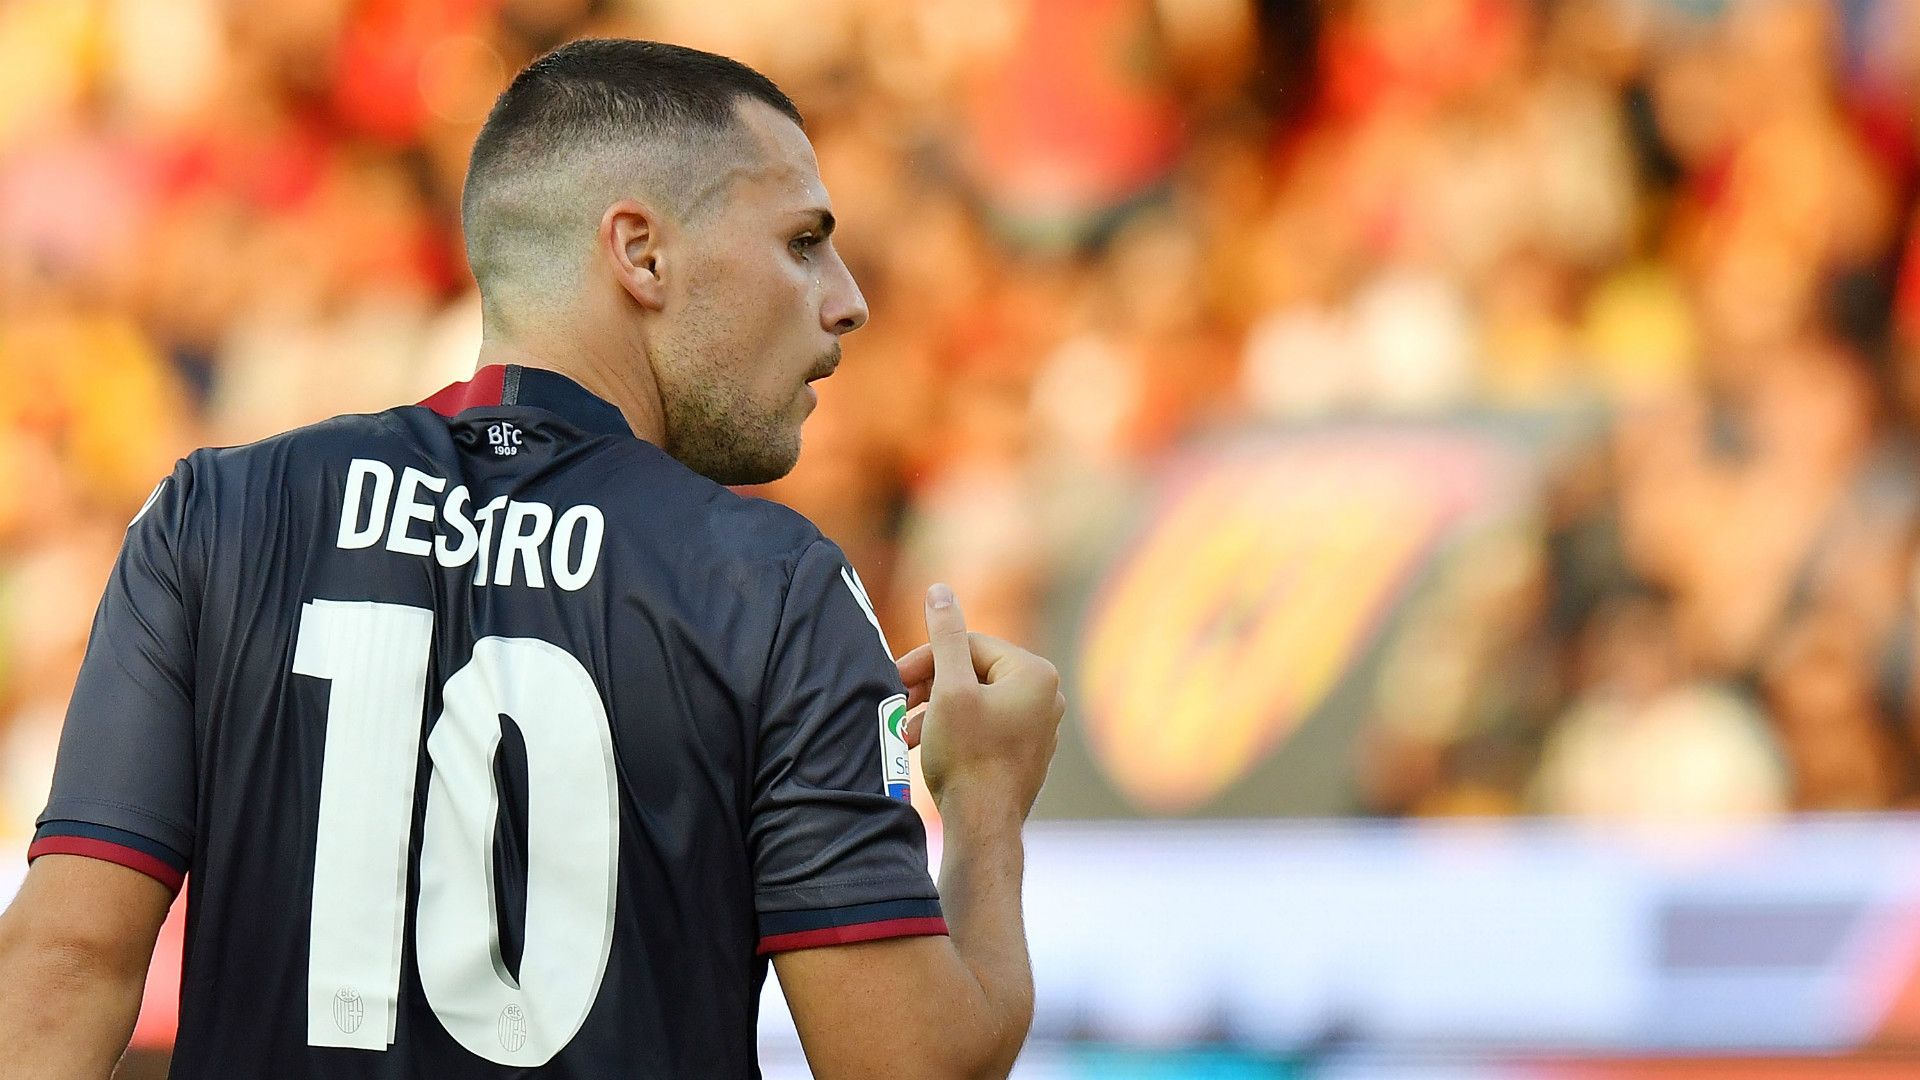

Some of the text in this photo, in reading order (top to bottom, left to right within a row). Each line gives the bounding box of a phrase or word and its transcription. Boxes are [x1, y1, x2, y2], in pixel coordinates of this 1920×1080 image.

[494, 446, 517, 456] 1909
[336, 458, 605, 592] DESTRO
[292, 598, 620, 1068] 10
